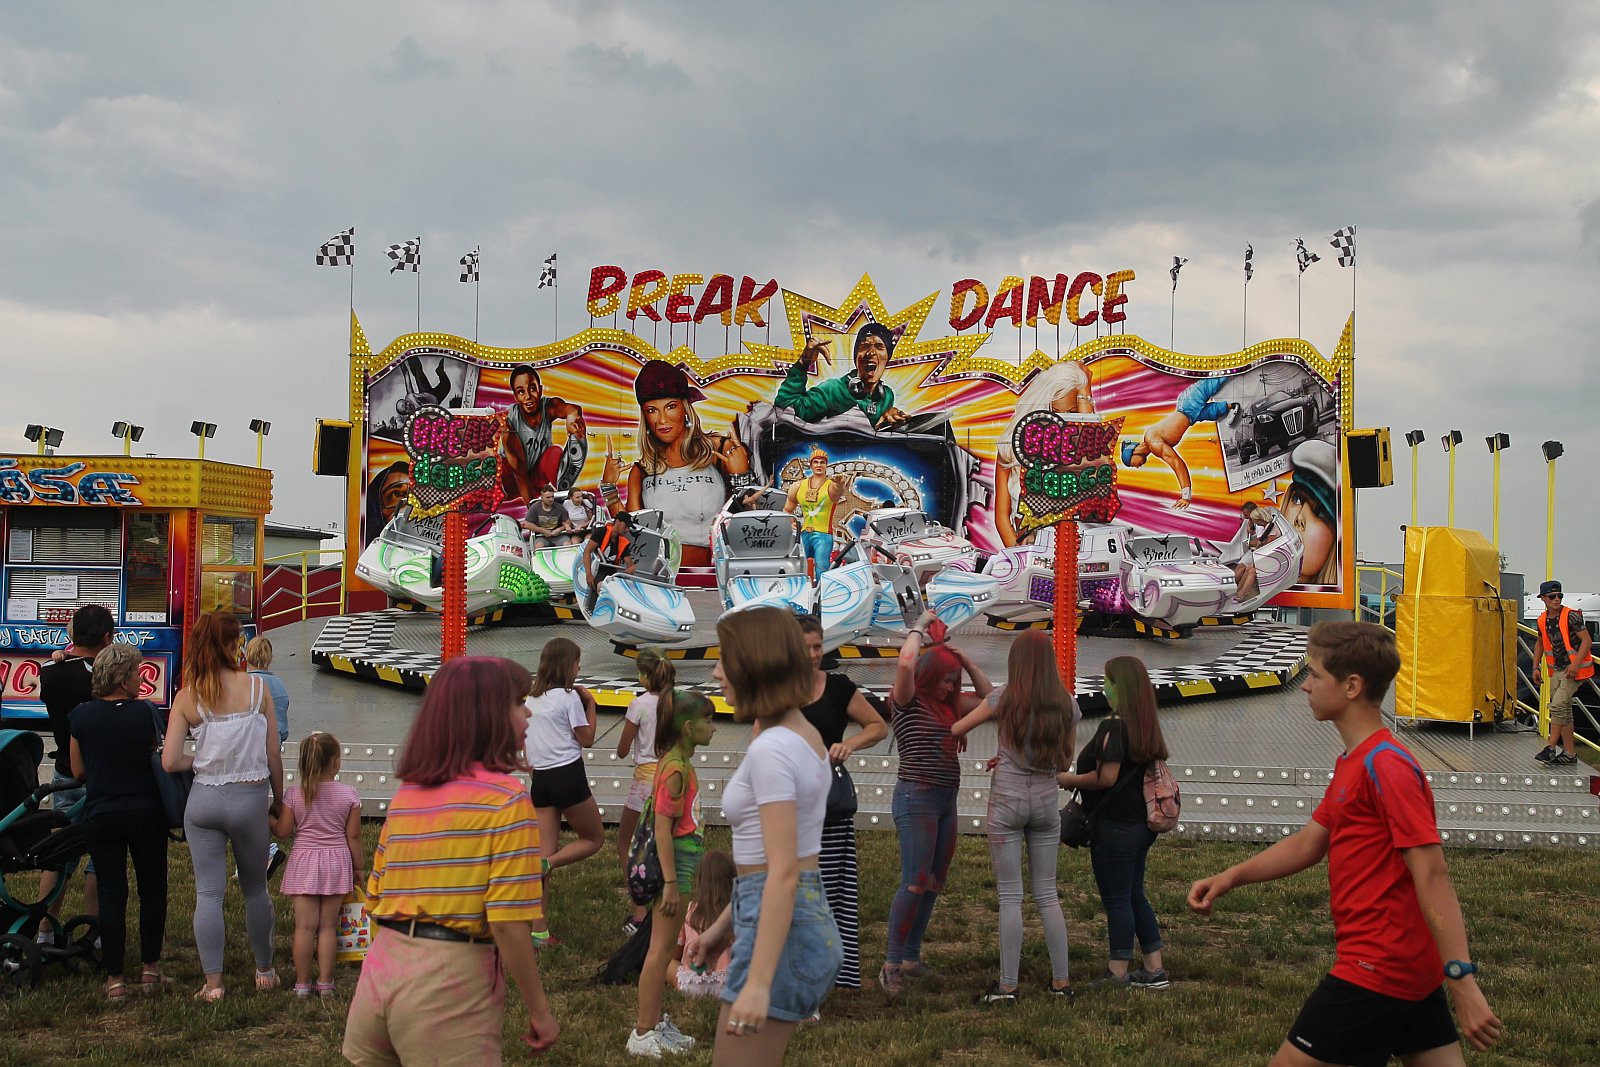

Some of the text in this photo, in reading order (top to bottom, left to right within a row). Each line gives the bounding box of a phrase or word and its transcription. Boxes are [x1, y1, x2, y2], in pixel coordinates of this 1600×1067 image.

[587, 265, 1136, 331] BREAK DANCE
[413, 417, 499, 457] BREAK
[1024, 423, 1116, 465] BREAK
[1107, 538, 1118, 553] 6
